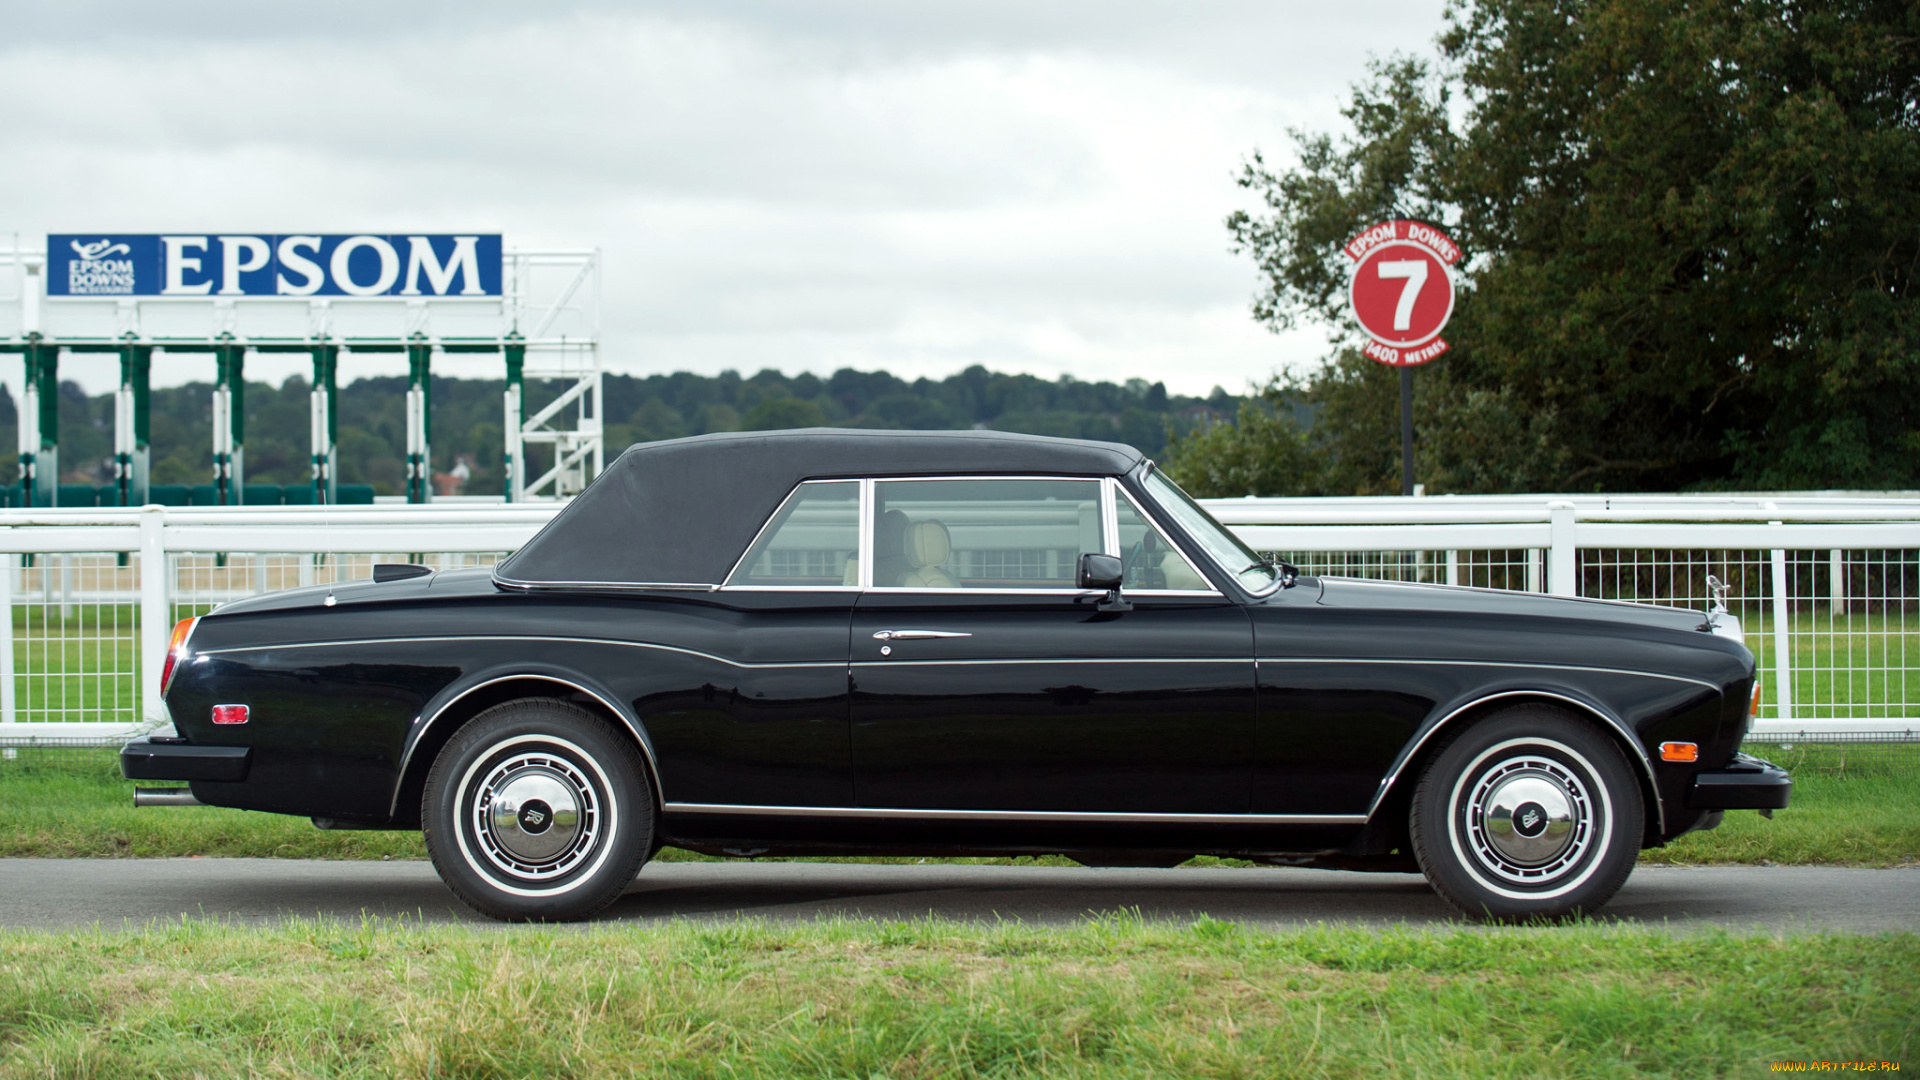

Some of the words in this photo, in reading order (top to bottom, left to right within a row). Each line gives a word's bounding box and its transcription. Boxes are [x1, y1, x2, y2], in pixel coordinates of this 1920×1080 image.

[1350, 221, 1396, 258] EPSOM
[1408, 223, 1457, 261] DOWNS
[69, 259, 133, 276] EPSOM
[69, 274, 135, 288] DOWNS
[160, 235, 486, 296] EPSOM
[1377, 260, 1428, 331] 7
[1365, 341, 1398, 364] 1400
[1404, 339, 1446, 364] METRES
